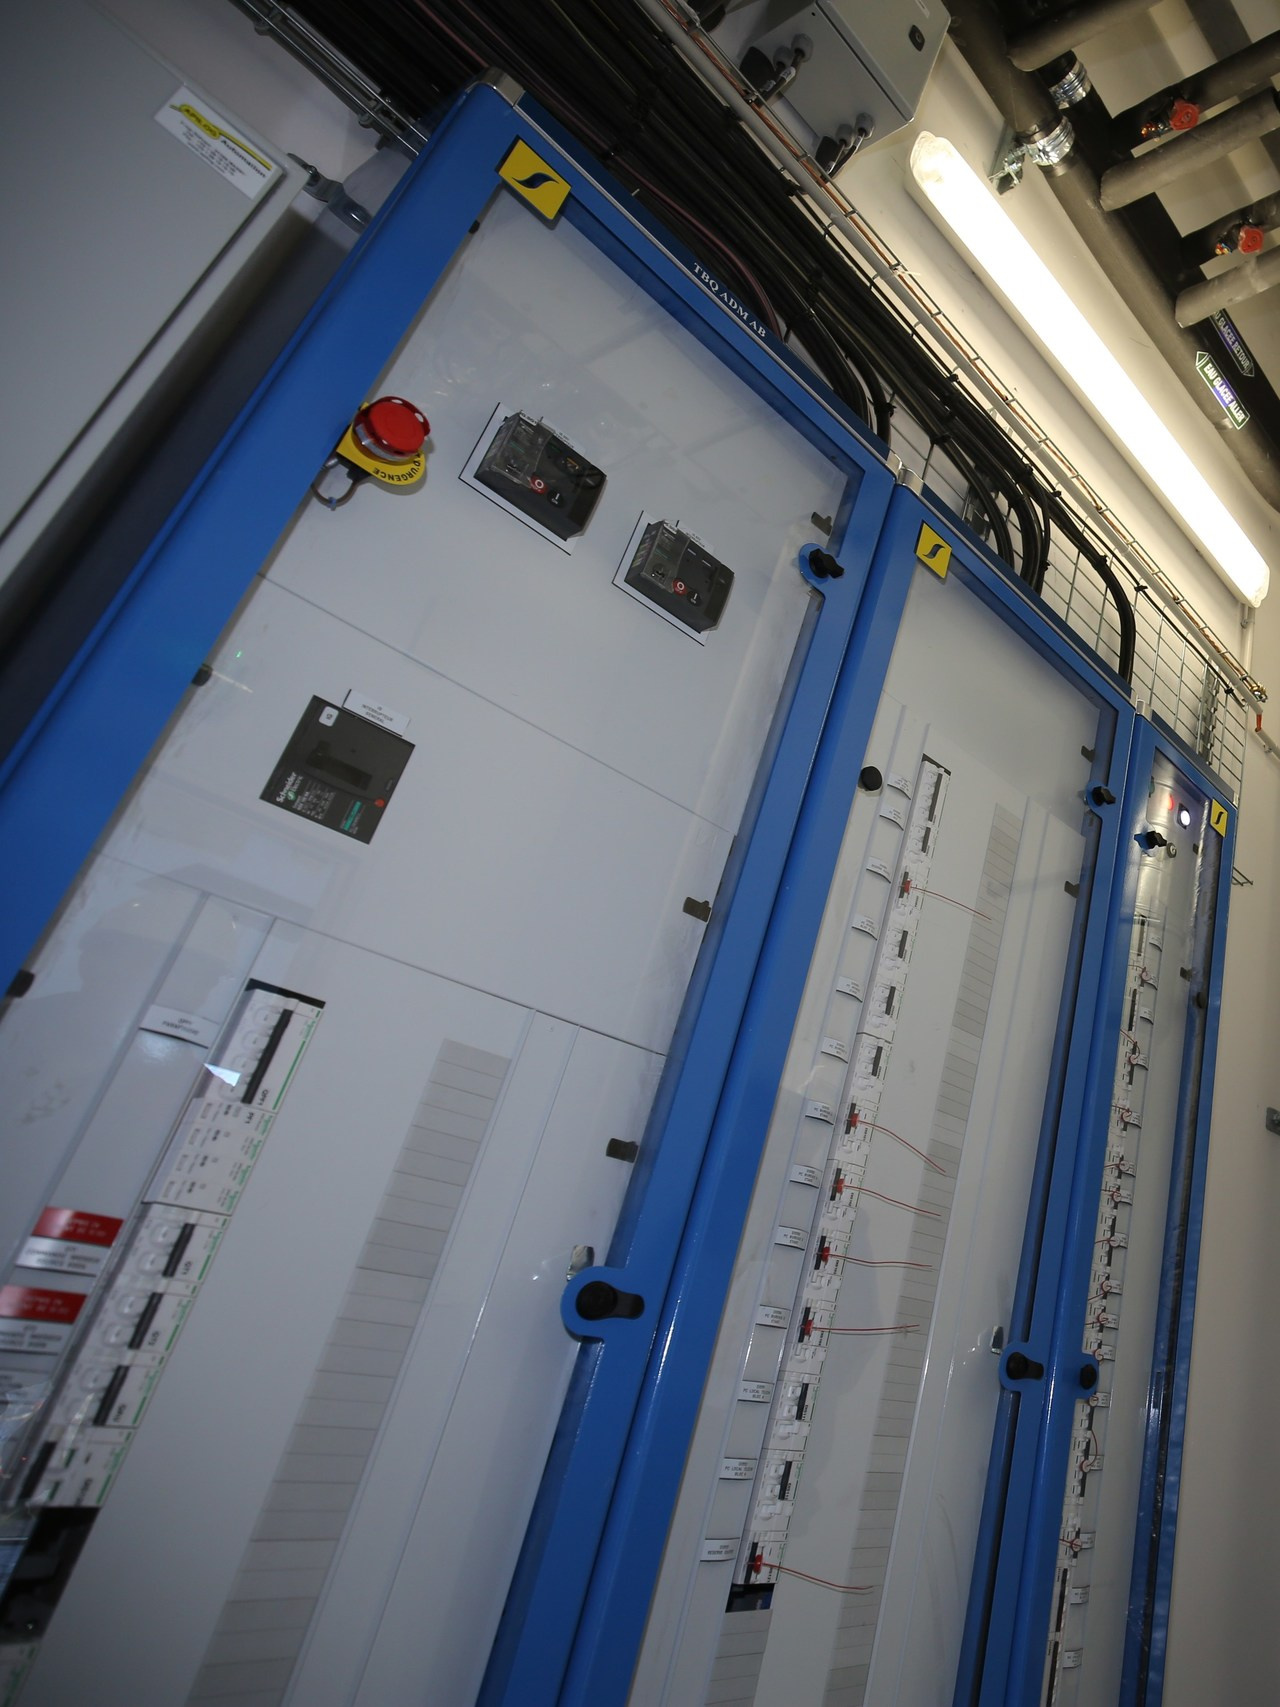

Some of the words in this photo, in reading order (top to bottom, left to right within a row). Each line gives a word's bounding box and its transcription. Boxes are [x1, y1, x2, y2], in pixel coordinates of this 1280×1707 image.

[221, 139, 266, 178] Automation
[693, 262, 719, 293] TBQ
[720, 292, 749, 321] ADM
[749, 320, 766, 338] AB
[1219, 317, 1236, 345] GLACEE
[1232, 341, 1250, 368] RETOUR
[1203, 362, 1218, 380] EAU
[1213, 377, 1235, 404] GLACEE
[1228, 400, 1246, 422] ALLER
[276, 771, 297, 803] Schneider
